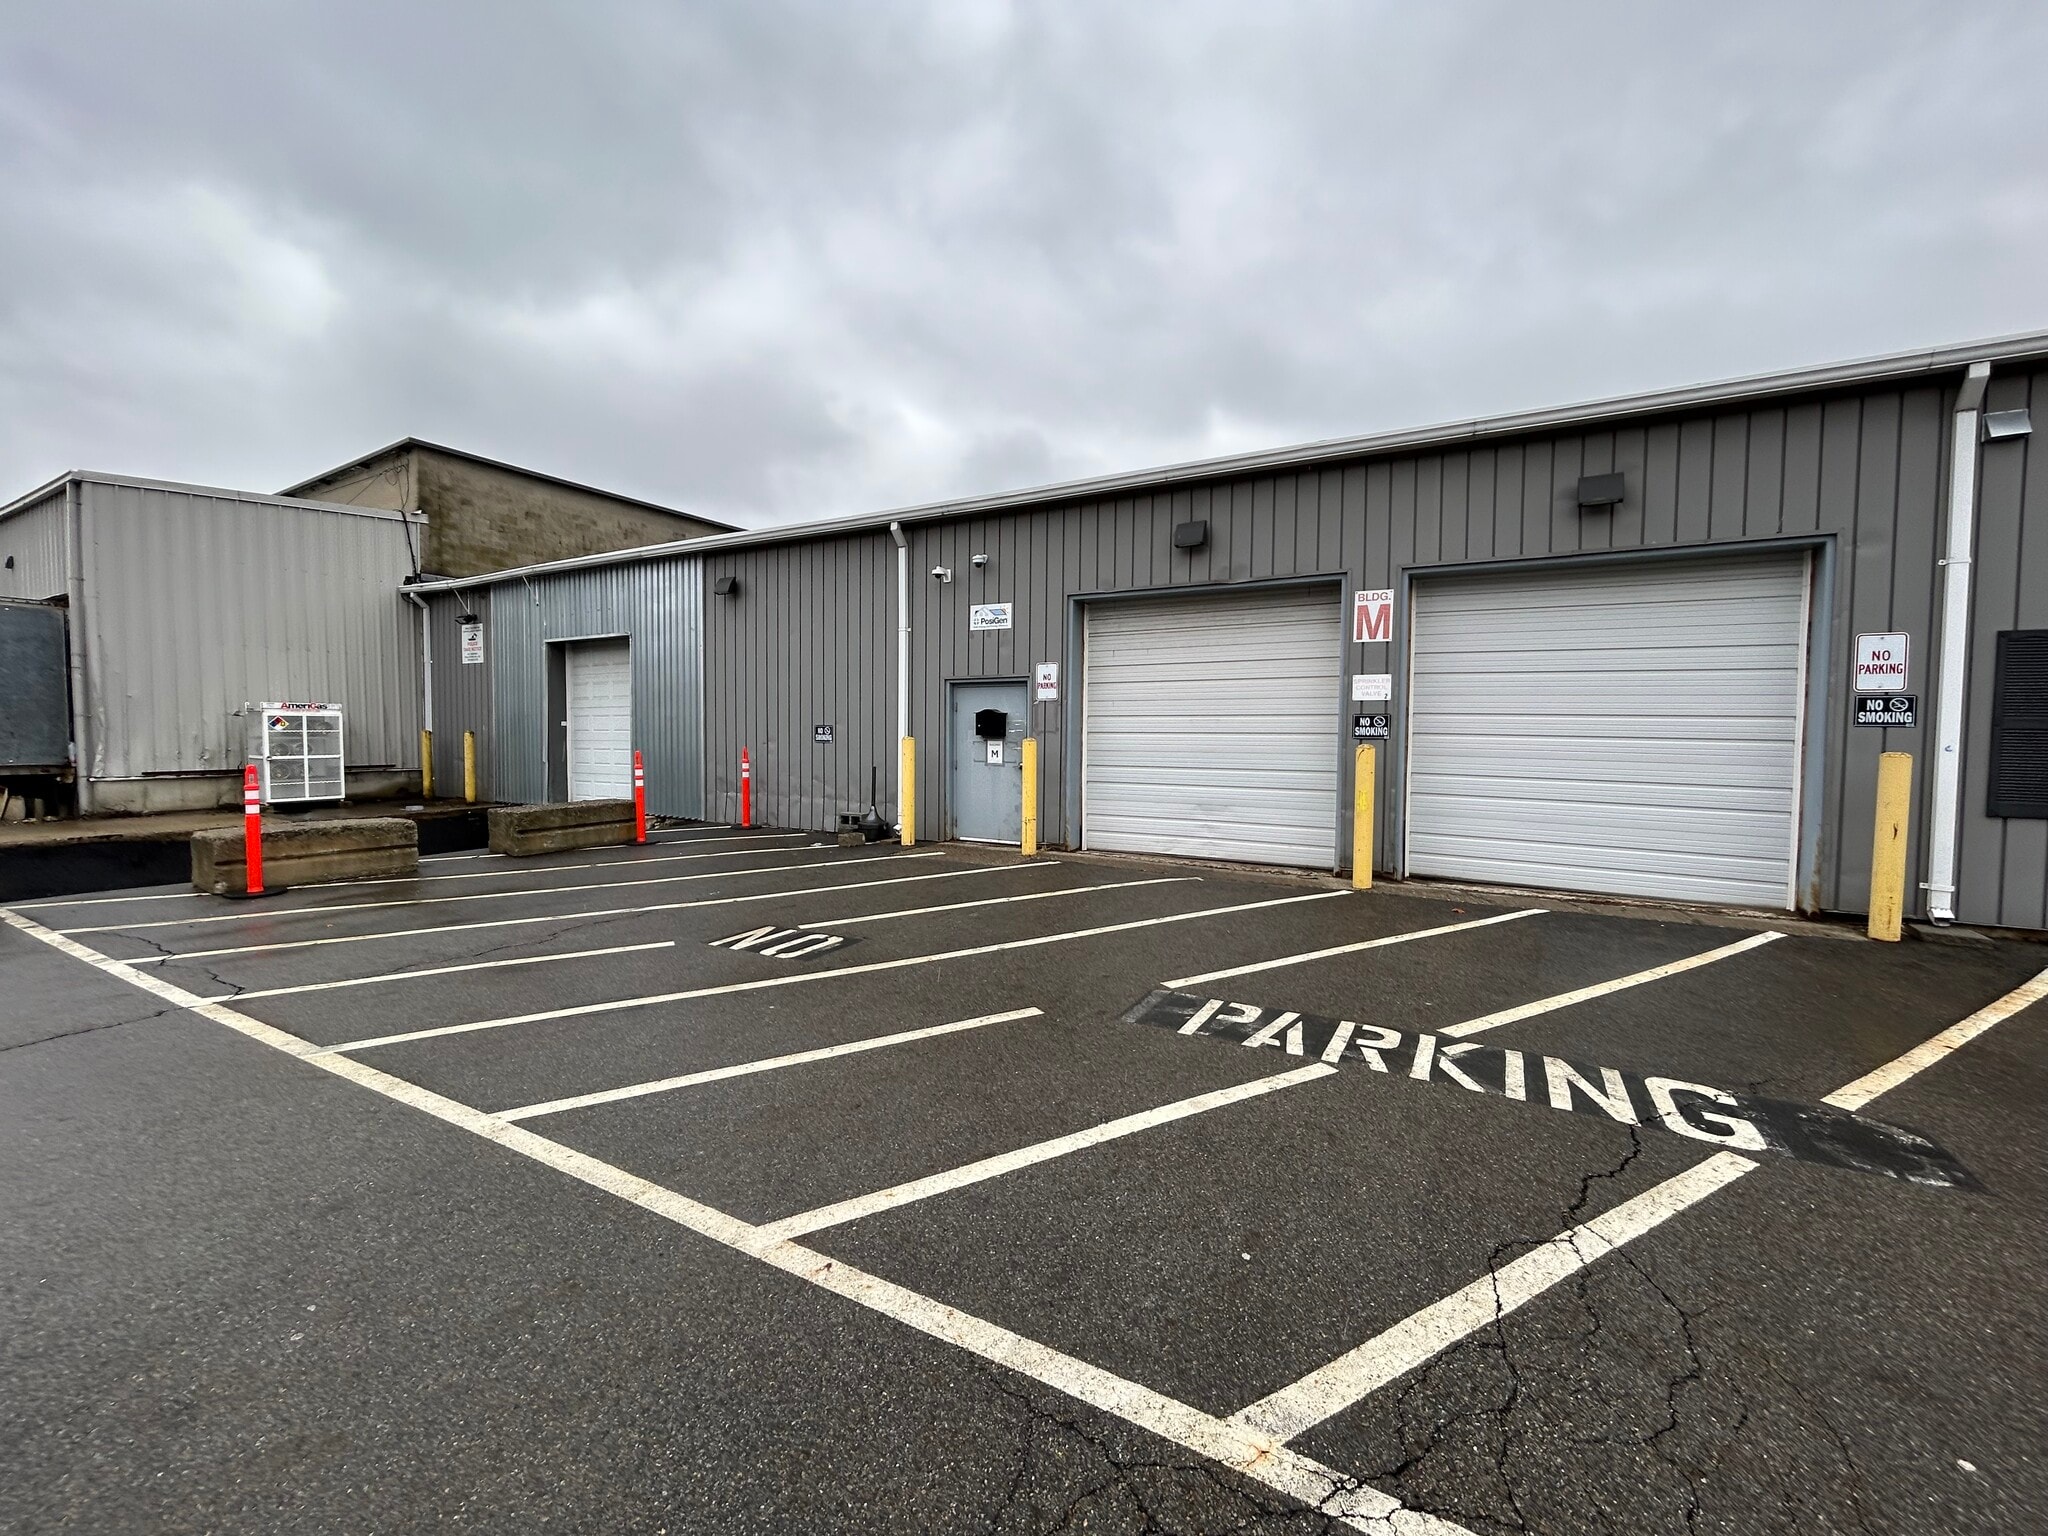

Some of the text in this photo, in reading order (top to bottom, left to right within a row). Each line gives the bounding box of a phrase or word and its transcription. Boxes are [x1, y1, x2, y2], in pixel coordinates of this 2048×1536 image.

[1358, 591, 1392, 601] BLDG.
[980, 616, 1008, 625] PosiGen
[1356, 603, 1391, 640] M
[1872, 650, 1891, 661] NO
[1858, 663, 1904, 675] PARKING
[1042, 673, 1052, 681] NO
[281, 702, 328, 710] AmeriGas
[1866, 700, 1884, 711] NO
[1360, 717, 1371, 726] NO
[1857, 711, 1913, 723] SMOKING
[1354, 726, 1388, 736] SMOKING
[991, 749, 999, 758] M
[708, 925, 844, 959] NO
[1177, 998, 1769, 1152] PARKING
